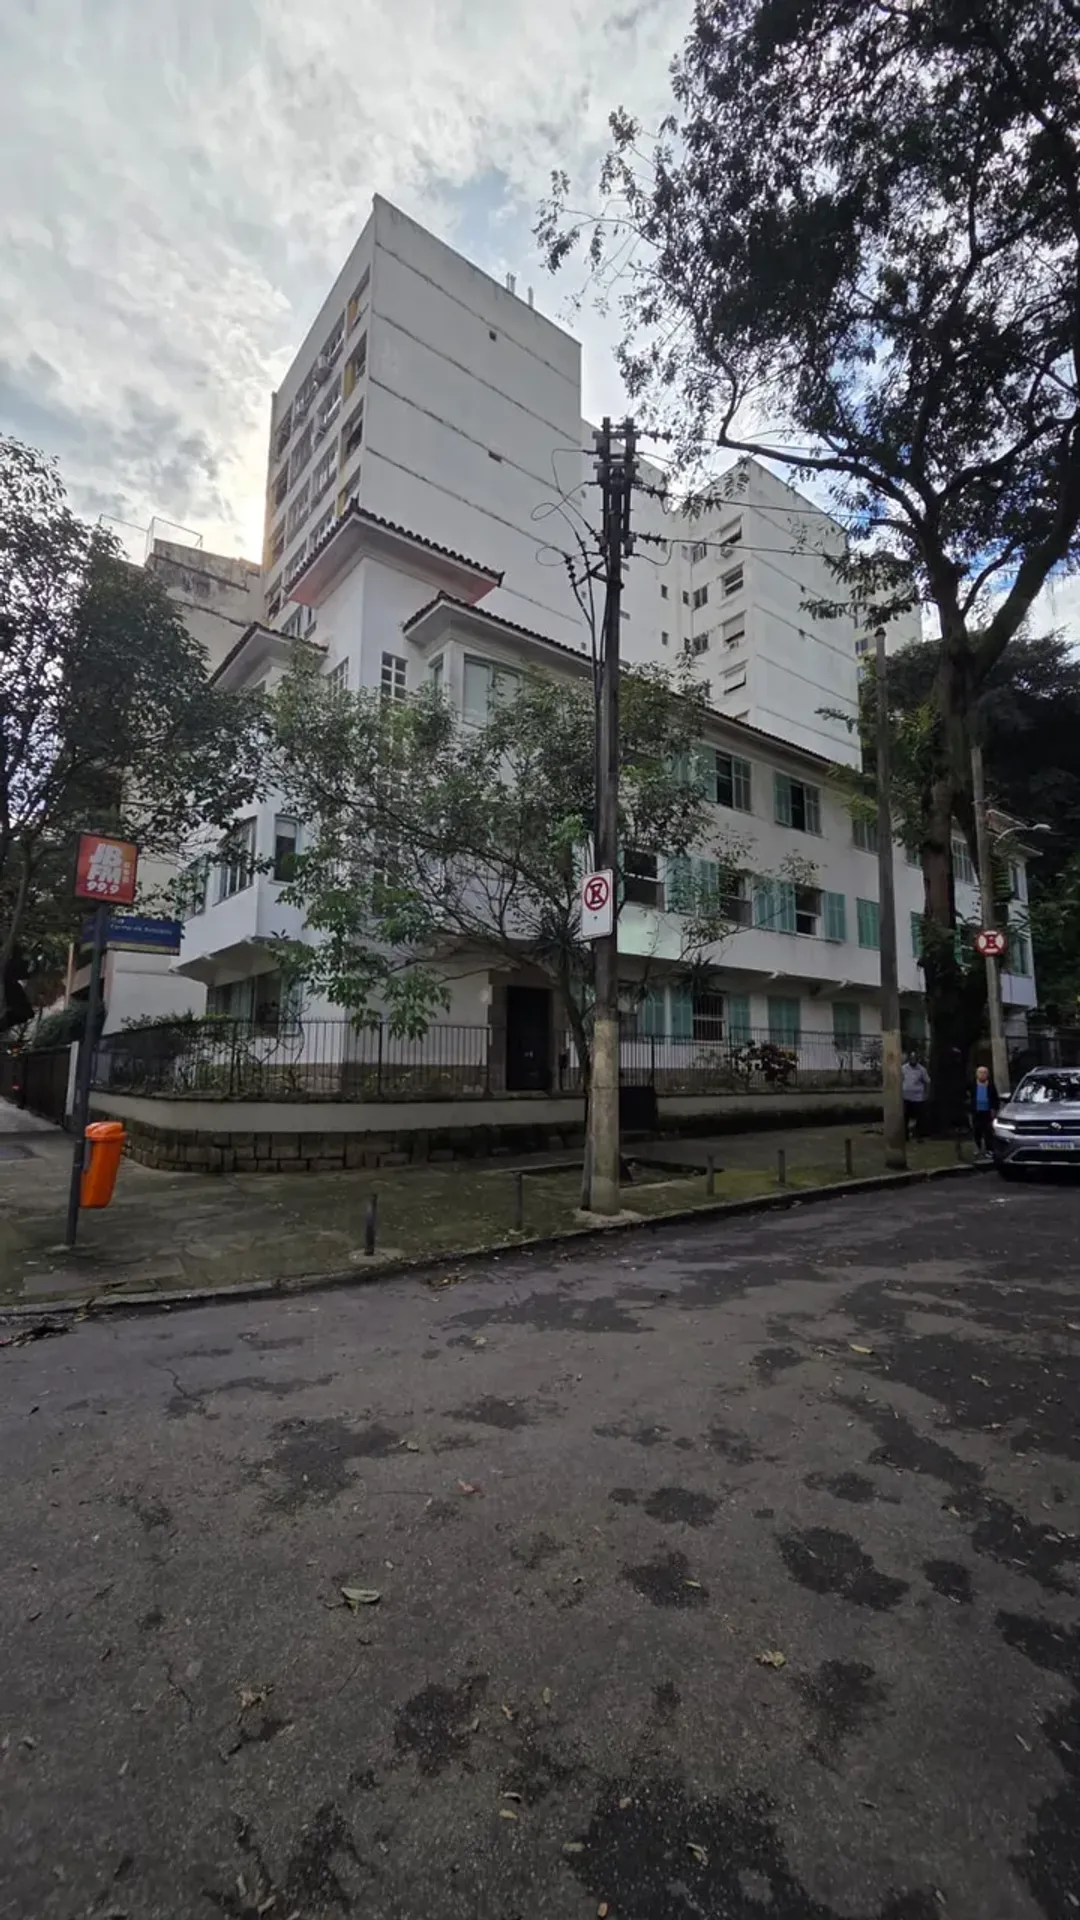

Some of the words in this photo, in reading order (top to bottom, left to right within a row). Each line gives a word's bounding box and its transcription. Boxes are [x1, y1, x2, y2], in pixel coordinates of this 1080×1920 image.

[88, 843, 123, 867] JB
[87, 864, 121, 884] FM
[86, 880, 120, 895] 99,9
